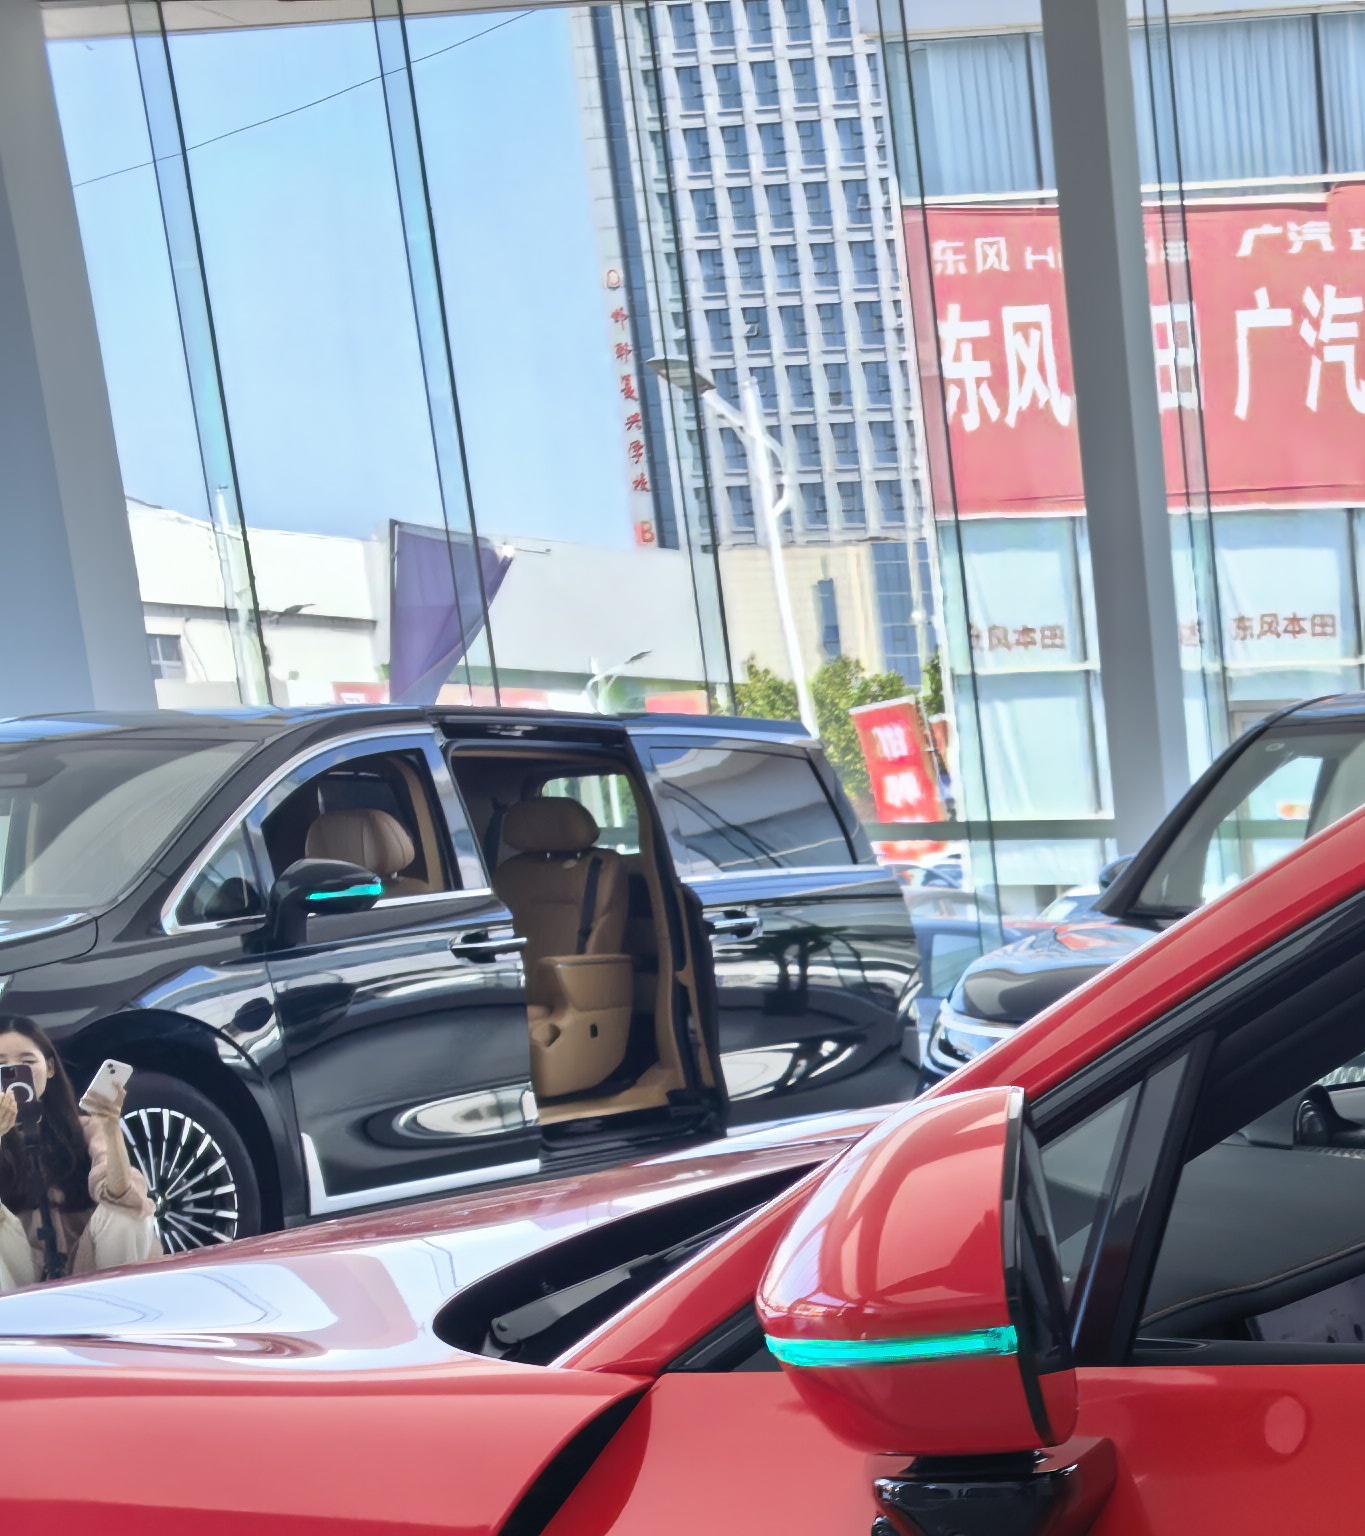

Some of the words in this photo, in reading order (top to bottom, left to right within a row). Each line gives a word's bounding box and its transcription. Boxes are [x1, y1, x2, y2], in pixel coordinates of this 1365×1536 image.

[932, 236, 1010, 275] 东风
[1236, 220, 1335, 257] 广汽
[937, 303, 1203, 433] 东风田
[1232, 612, 1338, 641] 东风本田
